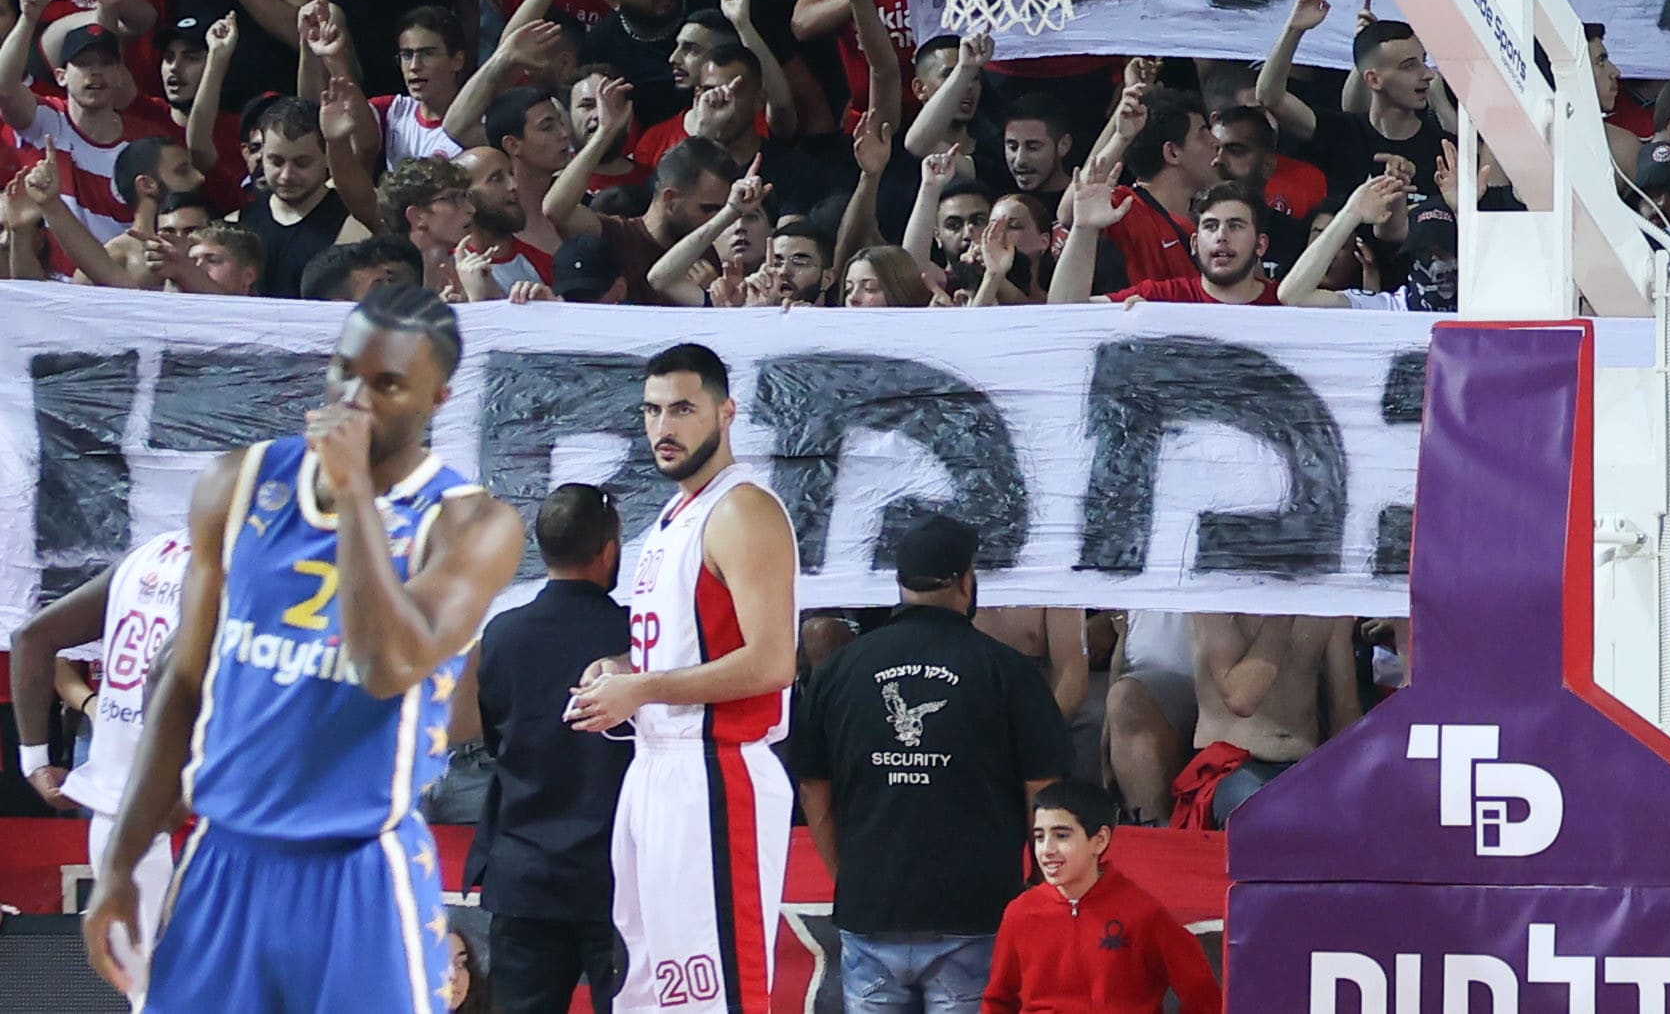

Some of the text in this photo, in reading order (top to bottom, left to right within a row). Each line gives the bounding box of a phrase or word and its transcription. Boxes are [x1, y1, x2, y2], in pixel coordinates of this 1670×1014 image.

[1494, 15, 1528, 82] Sports
[282, 559, 341, 631] 2
[873, 664, 922, 684] עוצמה
[871, 752, 952, 767] SECURITY
[888, 771, 930, 786] בטחון
[655, 953, 721, 1008] 20
